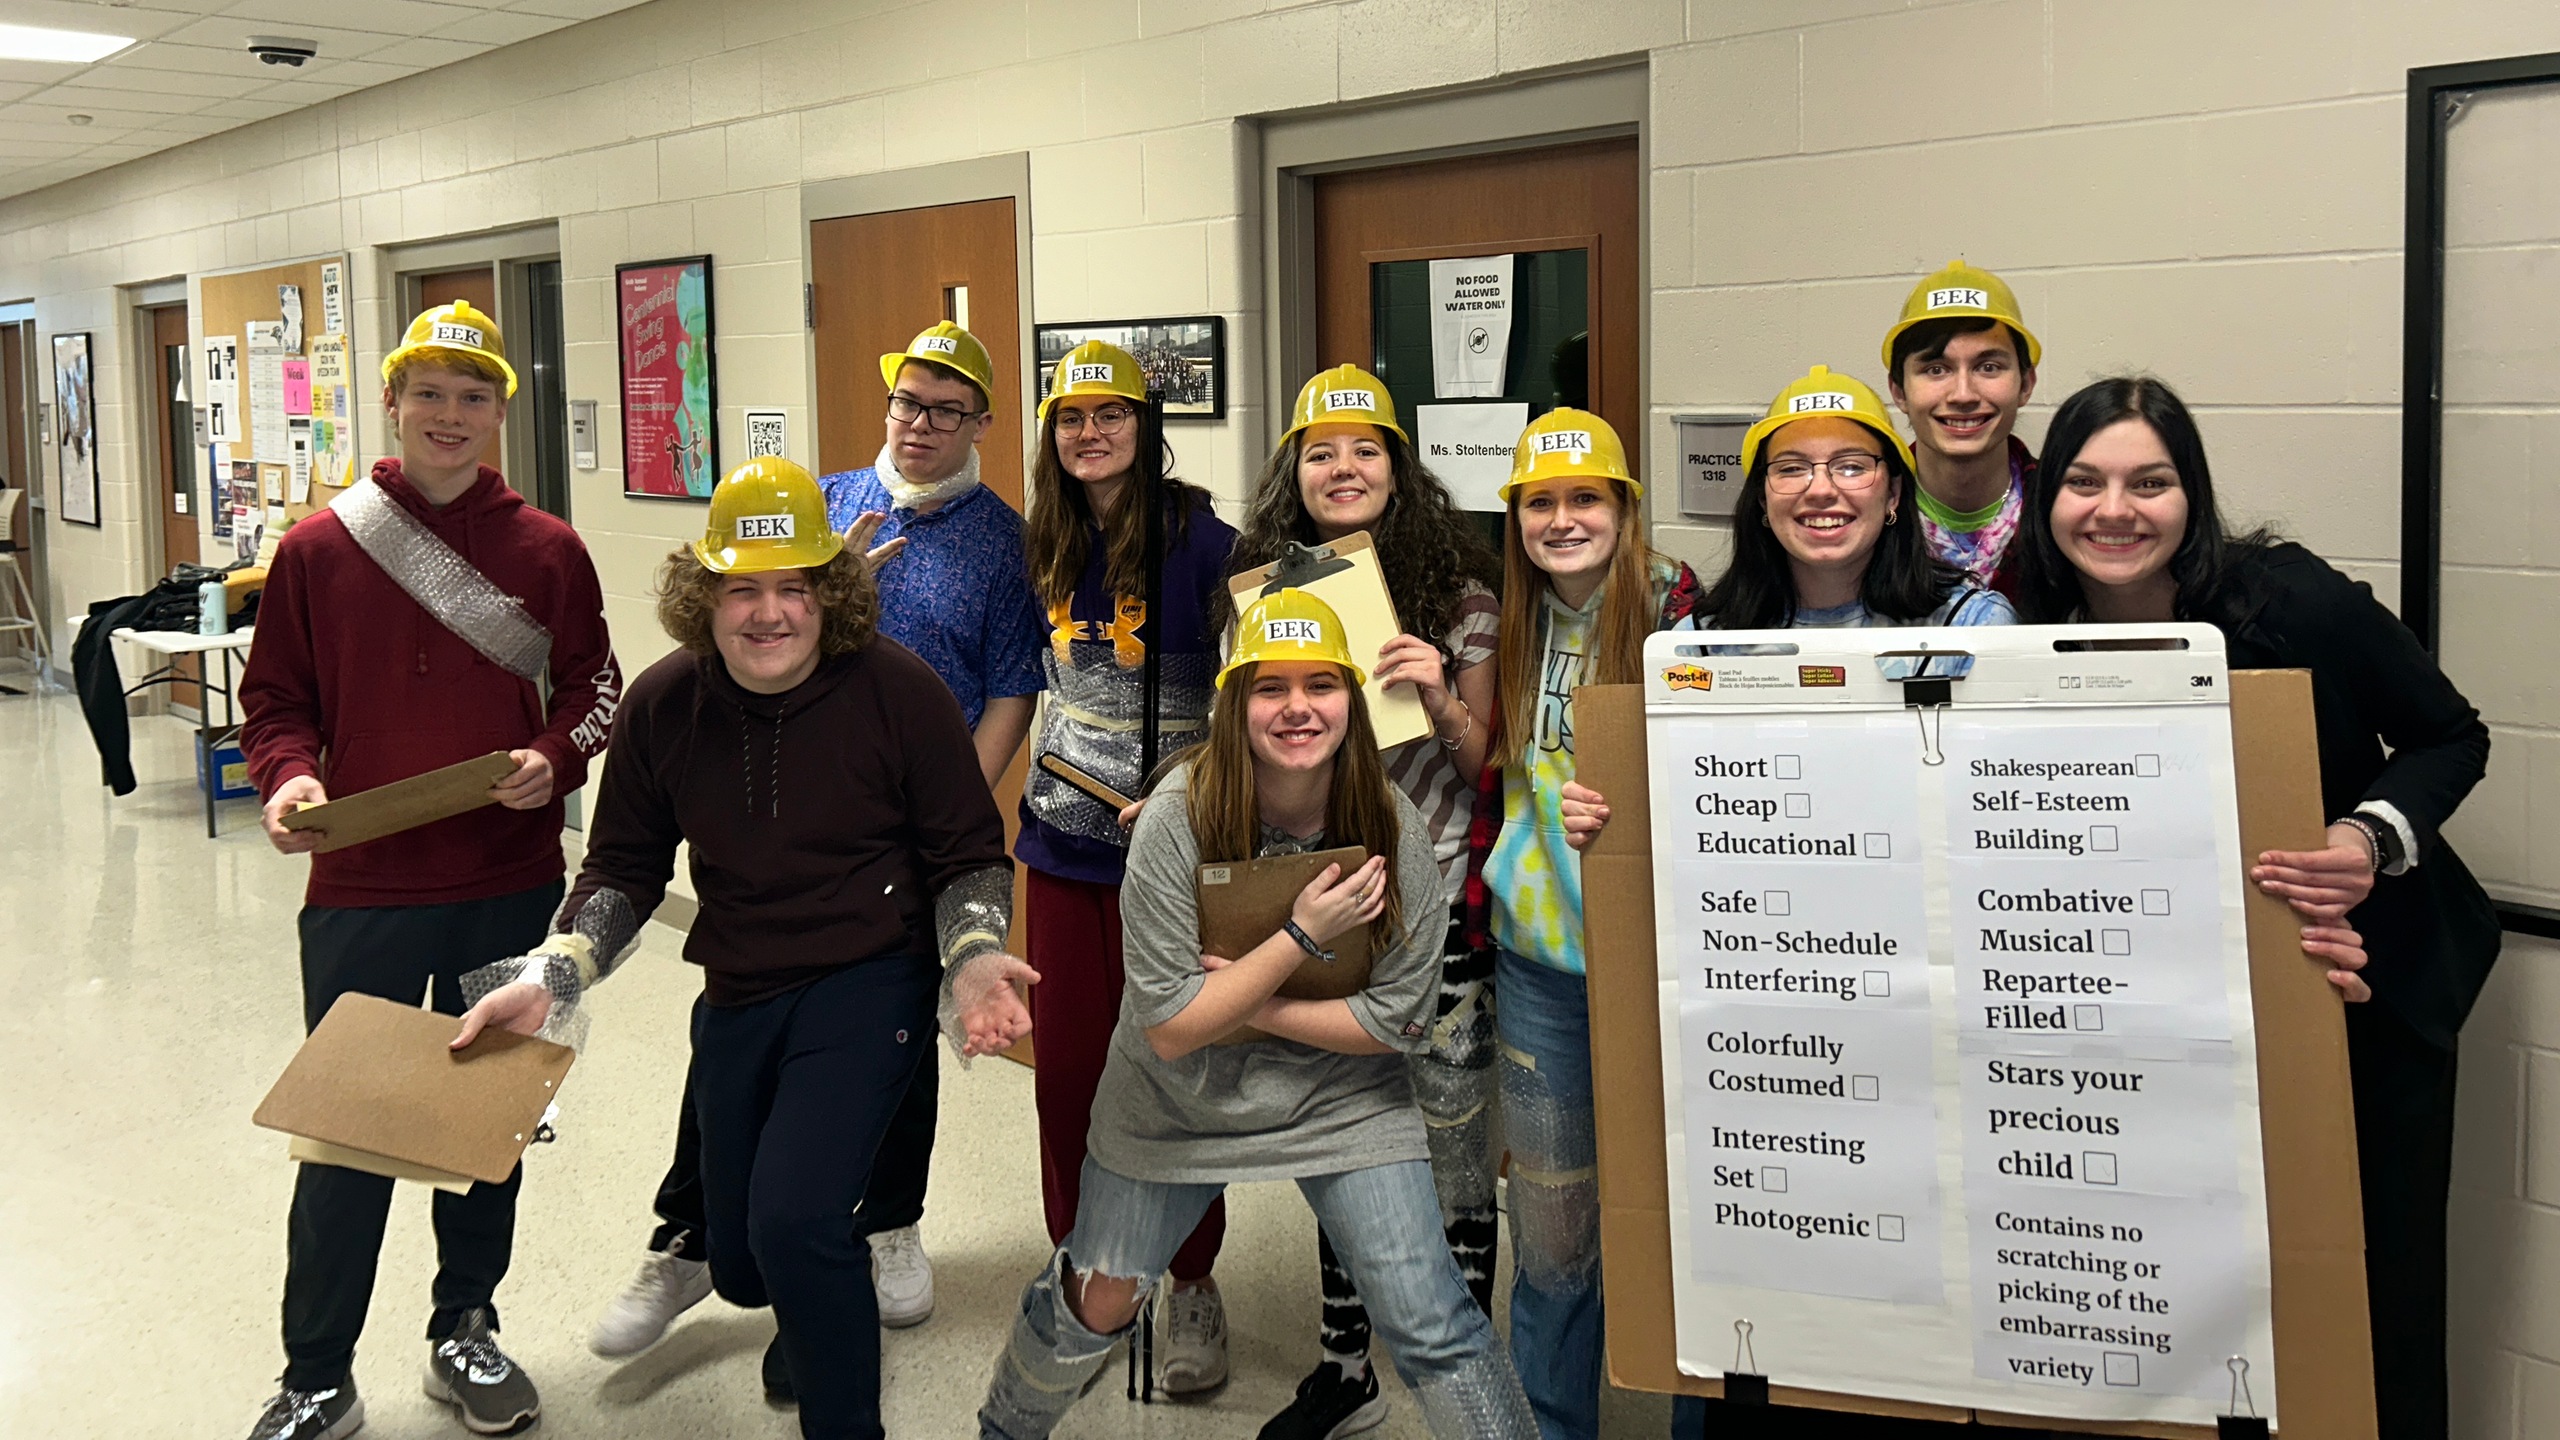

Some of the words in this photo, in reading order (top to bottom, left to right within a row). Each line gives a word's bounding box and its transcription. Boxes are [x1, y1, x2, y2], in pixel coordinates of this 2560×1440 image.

[1456, 277, 1472, 285] NO
[1474, 275, 1498, 284] FOOD
[624, 279, 675, 326] Centennial
[1455, 288, 1500, 298] ALLOWED
[1932, 290, 1981, 307] EEK
[1445, 302, 1483, 311] WATER
[1485, 301, 1505, 309] ONLY
[437, 327, 479, 345] EEK
[636, 316, 665, 346] Swing
[919, 338, 952, 351] EK
[635, 341, 667, 372] Dance
[287, 368, 304, 380] Week
[1071, 366, 1108, 382] EEK
[1329, 392, 1370, 408] EEK
[1795, 395, 1846, 412] EEK
[1431, 445, 1452, 456] Ms.
[1541, 433, 1586, 451] EEK
[1689, 454, 1741, 465] PRACTICE
[1702, 471, 1726, 481] 1318
[741, 518, 788, 538] EEK
[1121, 605, 1143, 614] UNI
[1269, 621, 1316, 639] EEK
[1668, 672, 1708, 682] Post-it
[2190, 675, 2213, 687] 3M
[1695, 755, 1768, 777] Short
[1971, 759, 2134, 781] Shakespearean
[1696, 793, 1777, 822] Cheap
[1973, 790, 2130, 811] Self-Esteem
[1698, 832, 1856, 855] Educational
[1975, 829, 2083, 855] Building
[1212, 870, 1226, 880] 12
[1702, 890, 1756, 913] Safe
[1978, 888, 2132, 913] Combative
[1703, 930, 1897, 955] Non-Schedule
[1981, 929, 2094, 952] Musical
[1705, 968, 1856, 1001] Interfering
[1983, 969, 2128, 998] Repartee-
[1985, 1005, 2066, 1029] Filled
[1708, 1032, 1843, 1064] Colorfully
[1709, 1070, 1844, 1097] Costumed
[1989, 1061, 2063, 1086] Stars
[2071, 1071, 2143, 1094] your
[1989, 1107, 2119, 1135] precious
[1712, 1127, 1865, 1163] Interesting
[1999, 1151, 2073, 1179] child
[1714, 1166, 1754, 1188] Set
[1715, 1204, 1869, 1238] Photogenic
[1996, 1213, 2104, 1238] Contains
[2112, 1226, 2142, 1242] no
[1998, 1250, 2127, 1281] scratching
[2134, 1263, 2160, 1278] or
[1999, 1278, 2090, 1311] picking
[2098, 1289, 2122, 1309] of
[2129, 1292, 2168, 1314] the
[2000, 1314, 2171, 1353] embarrassing
[2008, 1357, 2093, 1385] variety
